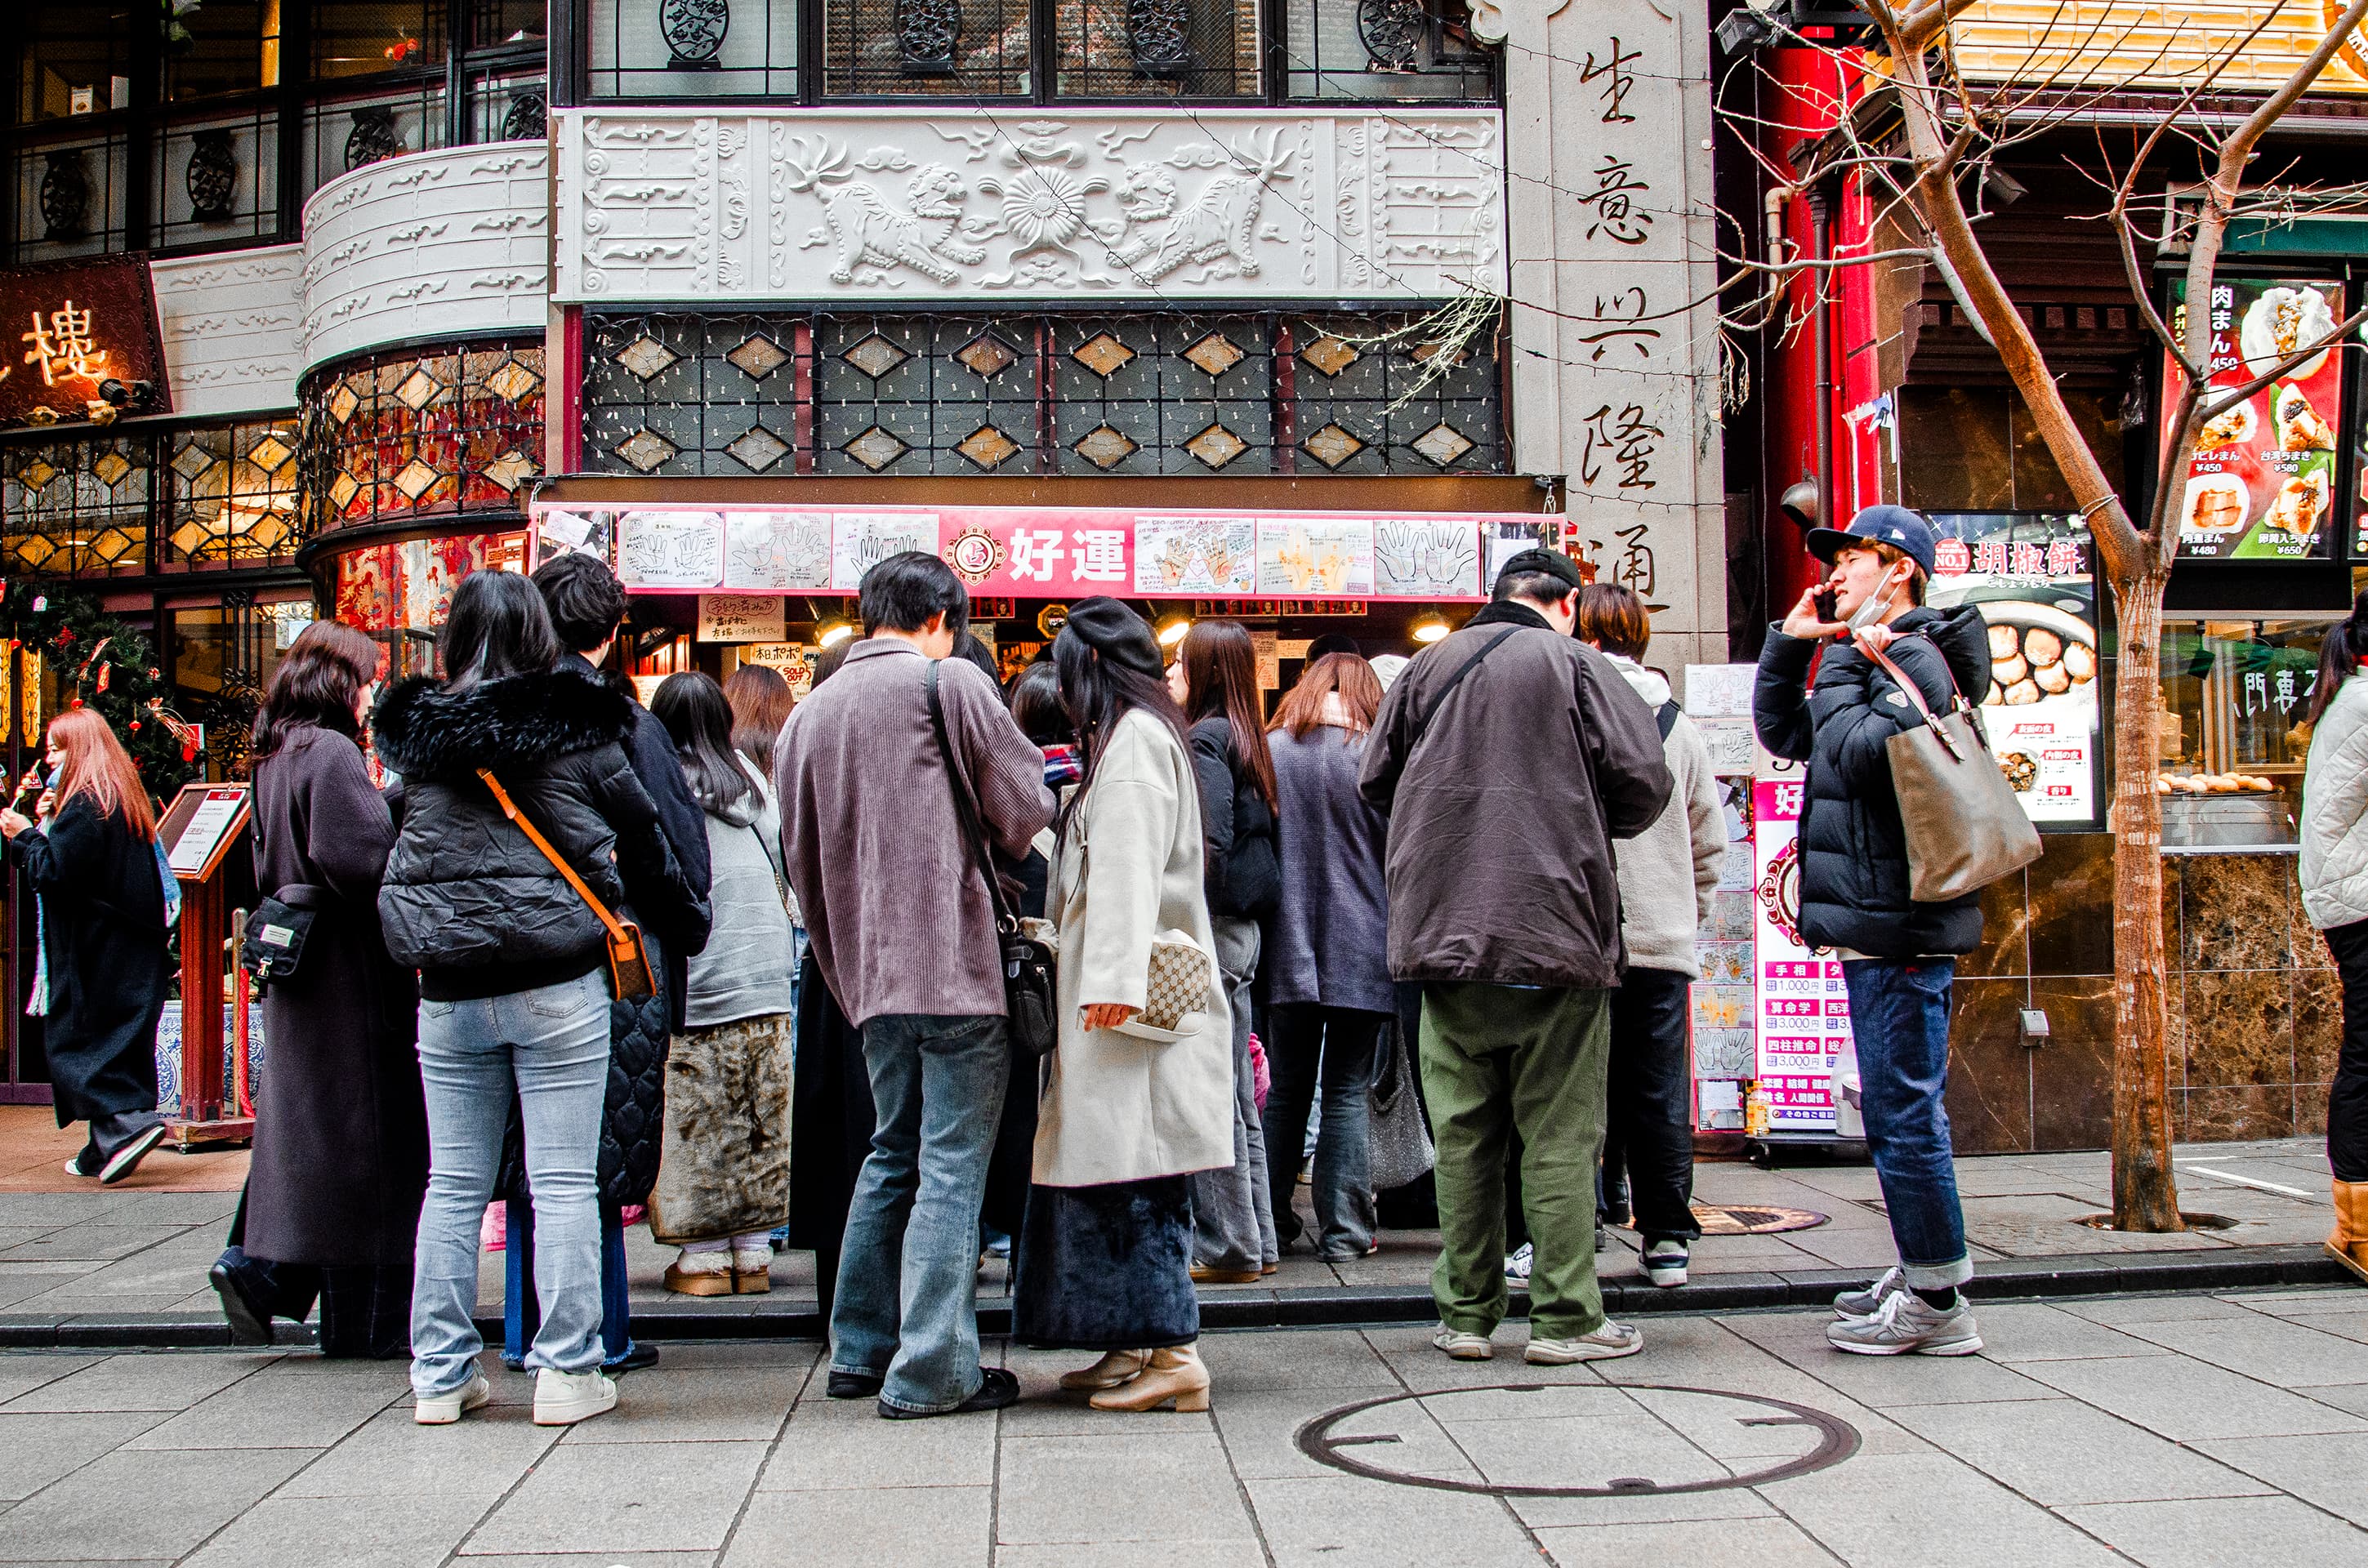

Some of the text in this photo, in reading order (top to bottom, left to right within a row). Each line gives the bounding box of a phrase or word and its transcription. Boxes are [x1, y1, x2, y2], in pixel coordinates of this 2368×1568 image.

[2210, 285, 2234, 354] 肉まん
[0, 299, 107, 387] 樓
[2260, 451, 2312, 461] 台湾ちまき
[2196, 463, 2222, 473] ¥450
[2273, 463, 2299, 473] ¥580
[2182, 533, 2225, 544] 角煮まん
[1009, 528, 1127, 582] 好運
[2191, 546, 2218, 555] ¥480
[2277, 546, 2303, 555] ¥650
[1934, 554, 1968, 568] NO.1
[1987, 579, 2051, 589] こしょうもち
[783, 666, 805, 675] SOLD
[1775, 964, 1807, 977] 手相
[1770, 1001, 1811, 1014] 算命学
[1768, 1039, 1817, 1053] 四柱推命
[1786, 1079, 1808, 1089] 結婚
